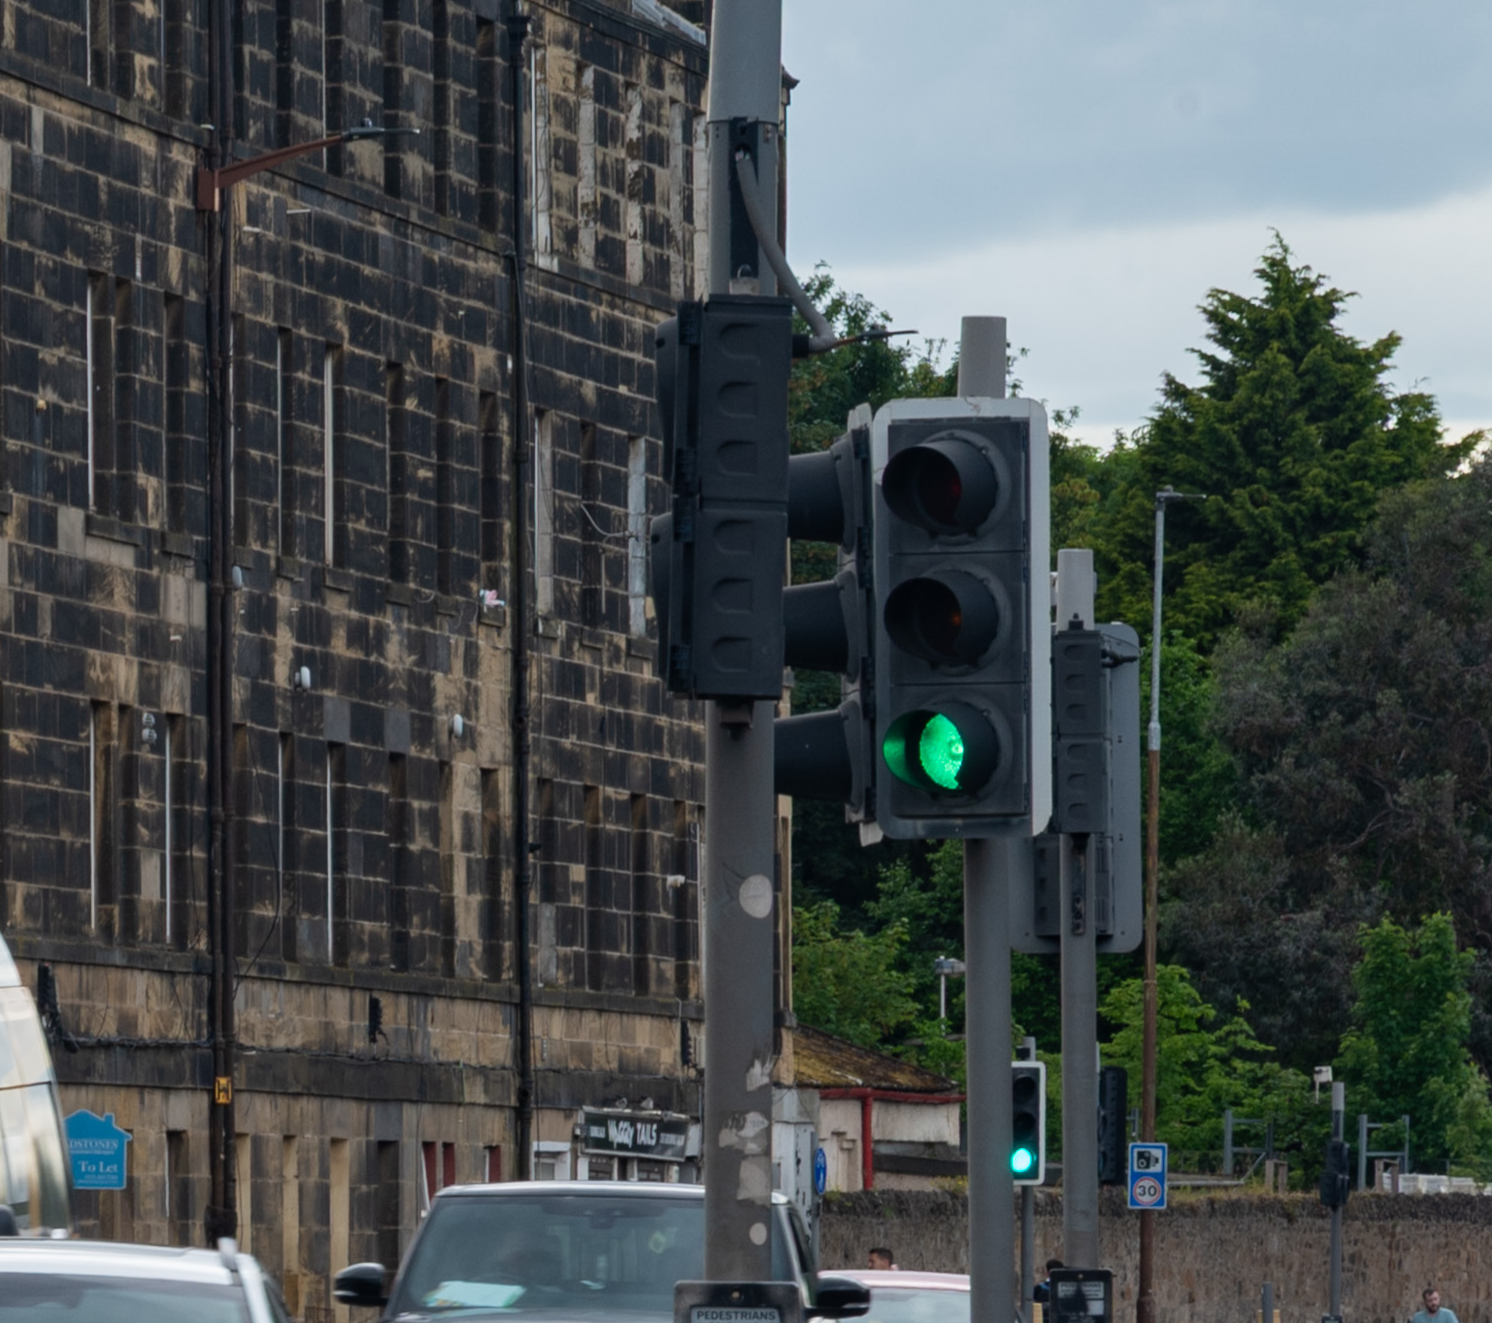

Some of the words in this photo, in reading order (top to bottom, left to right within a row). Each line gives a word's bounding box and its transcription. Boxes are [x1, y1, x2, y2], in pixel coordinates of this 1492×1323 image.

[636, 1122, 657, 1146] TAILS
[78, 1160, 96, 1173] To
[98, 1160, 118, 1173] Let
[1138, 1185, 1157, 1197] 30
[696, 1310, 776, 1321] PEDESTRIANS
